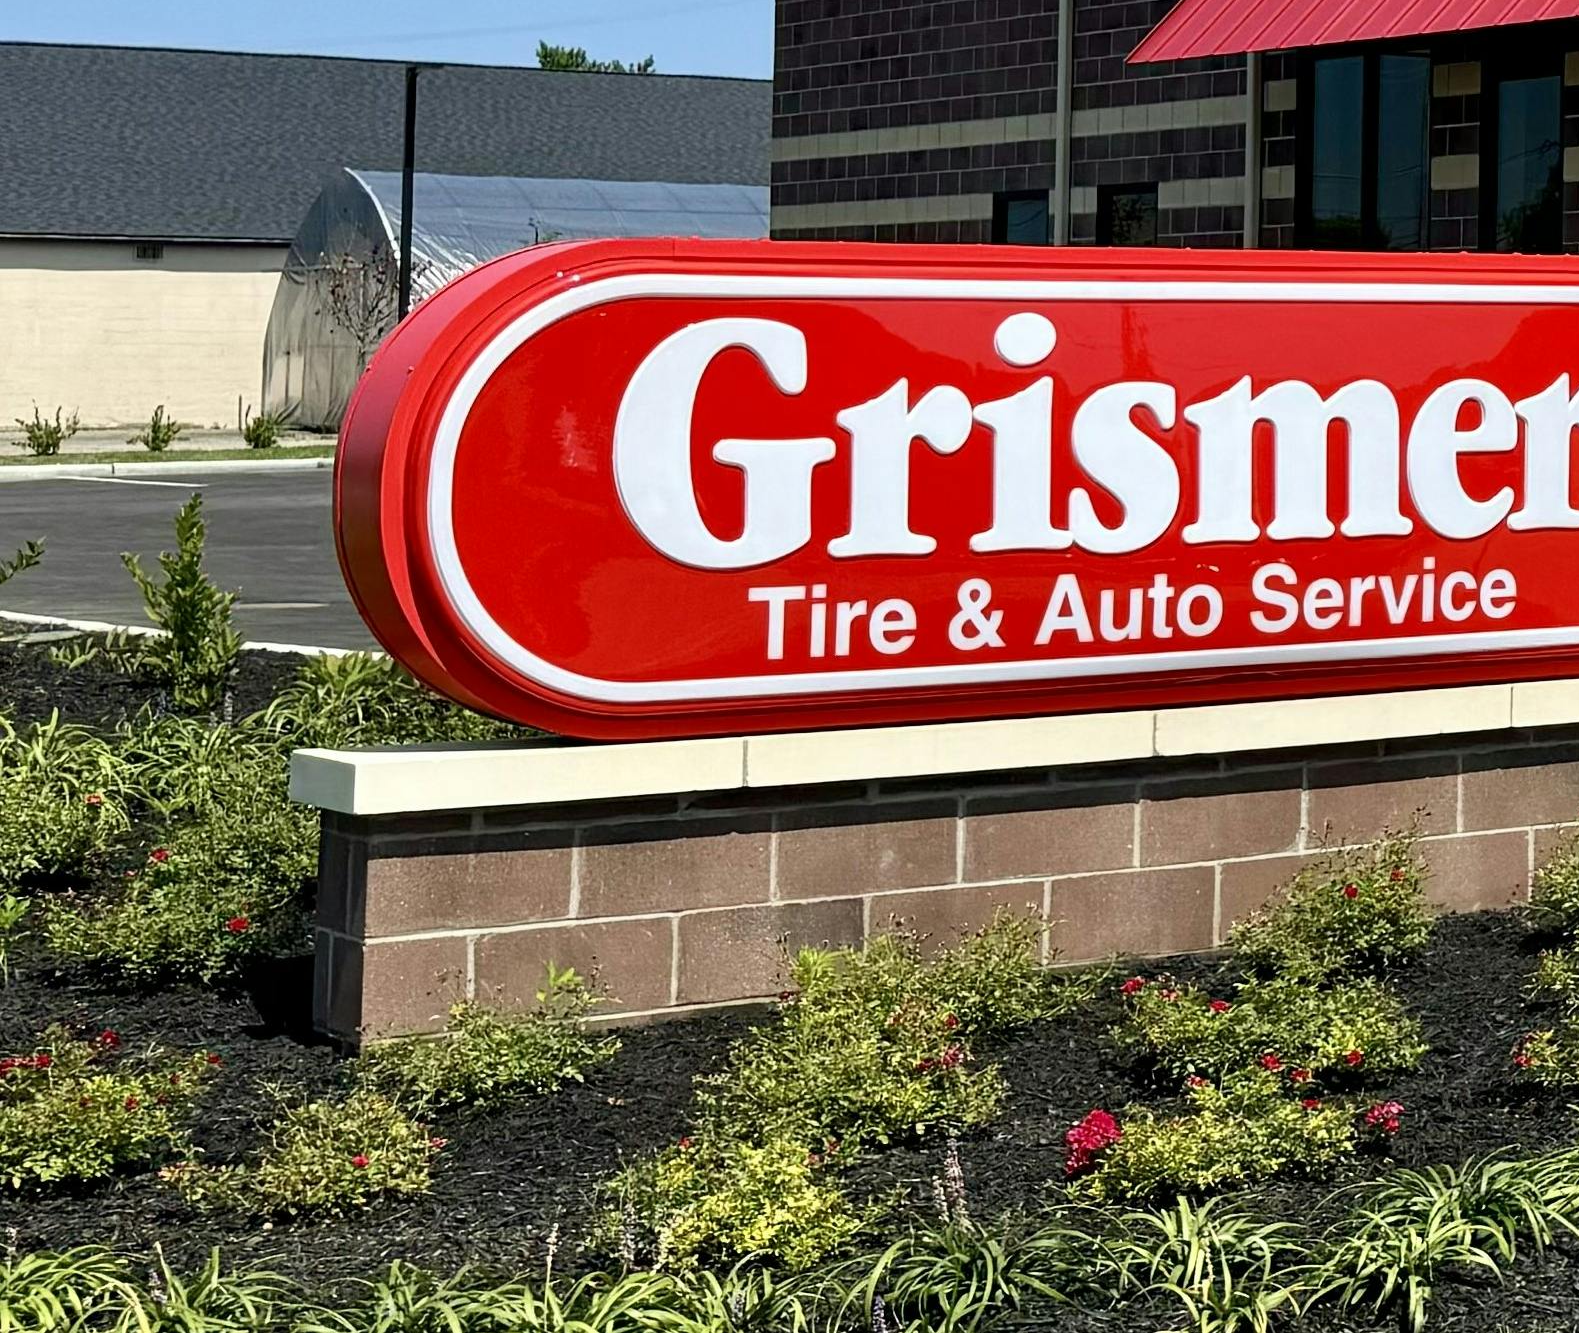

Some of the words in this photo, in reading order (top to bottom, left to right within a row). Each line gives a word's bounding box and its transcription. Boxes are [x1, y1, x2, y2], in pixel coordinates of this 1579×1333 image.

[747, 583, 917, 660] Tire
[947, 577, 1006, 651] &
[1034, 572, 1224, 645] Auto
[1249, 555, 1518, 634] Service
